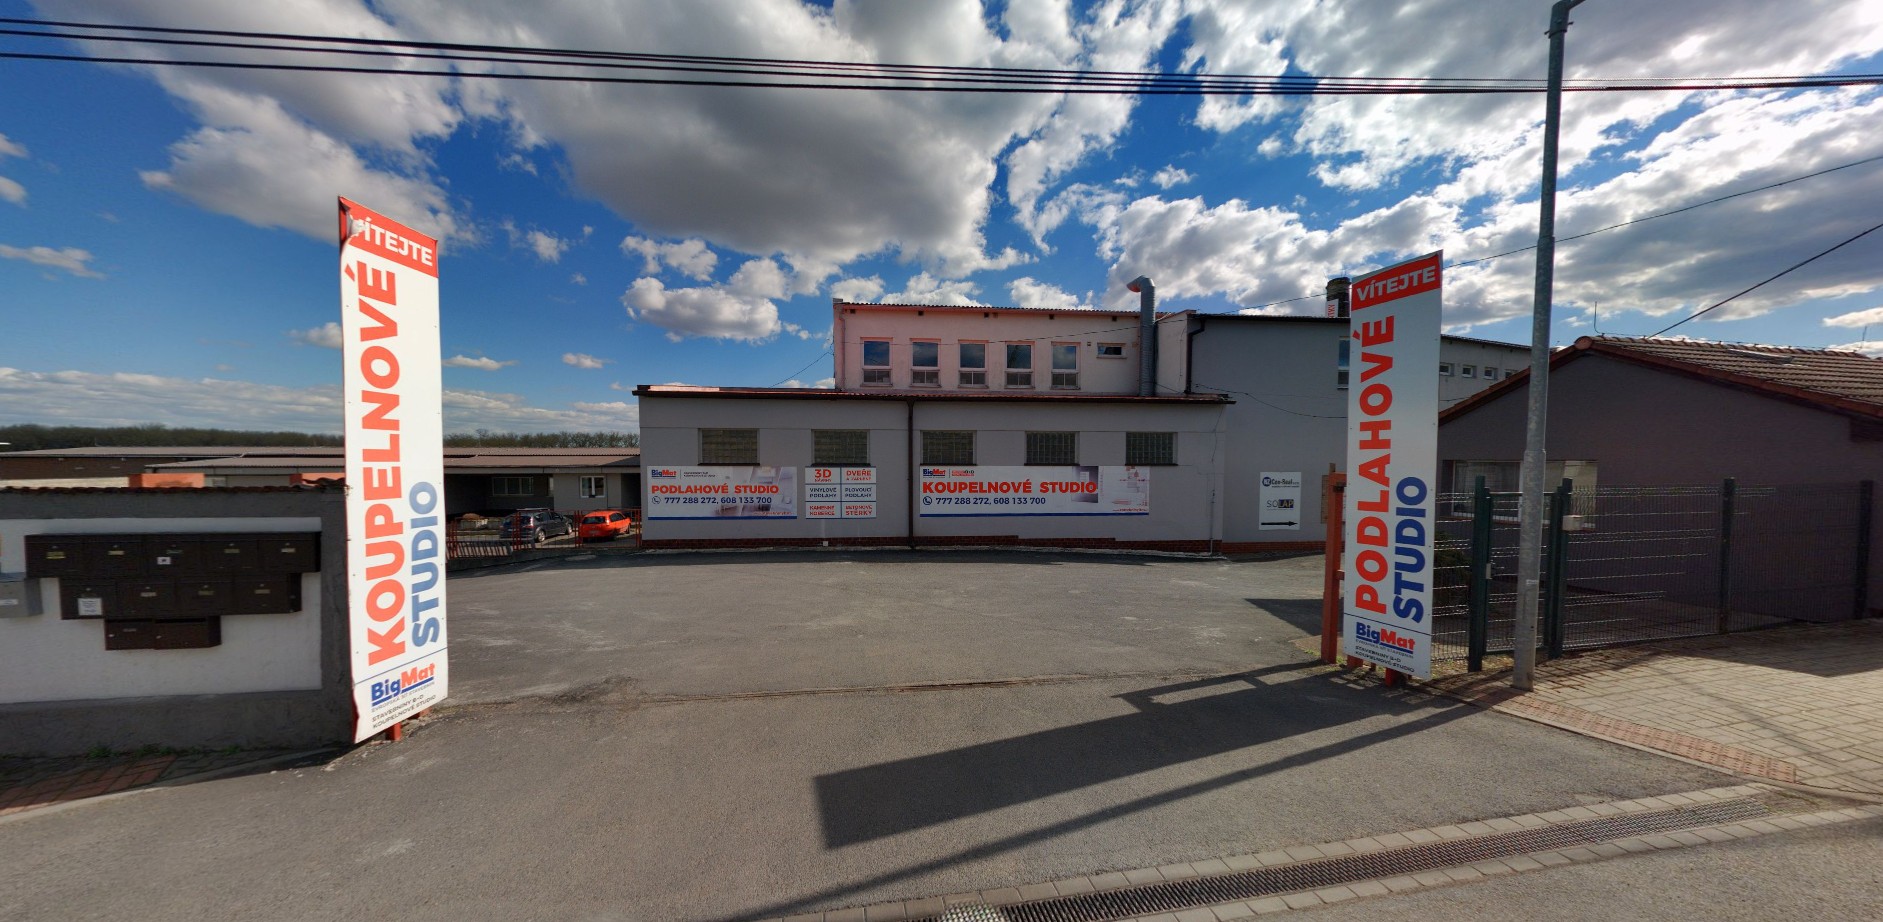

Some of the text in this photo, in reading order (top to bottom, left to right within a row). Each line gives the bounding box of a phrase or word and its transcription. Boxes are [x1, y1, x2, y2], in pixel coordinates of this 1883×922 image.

[1356, 265, 1436, 301] VÍTEJTE
[344, 260, 407, 666] KOUPELNOVÉ
[651, 469, 677, 477] BigMat
[814, 469, 832, 479] 3D
[922, 468, 946, 476] BigMat
[1352, 314, 1395, 615] PODLAHOVÉ
[651, 483, 779, 494] PODLAHOVÉ STUDIO
[922, 479, 1032, 494] KOUPELNOVÉ
[1039, 481, 1097, 494] STUDIO
[700, 497, 719, 505] 272,
[972, 497, 991, 506] 272,
[1393, 475, 1428, 624] STUDIO
[408, 480, 440, 649] STUDIO
[1355, 621, 1416, 650] BigMat
[371, 662, 435, 702] BigMat
